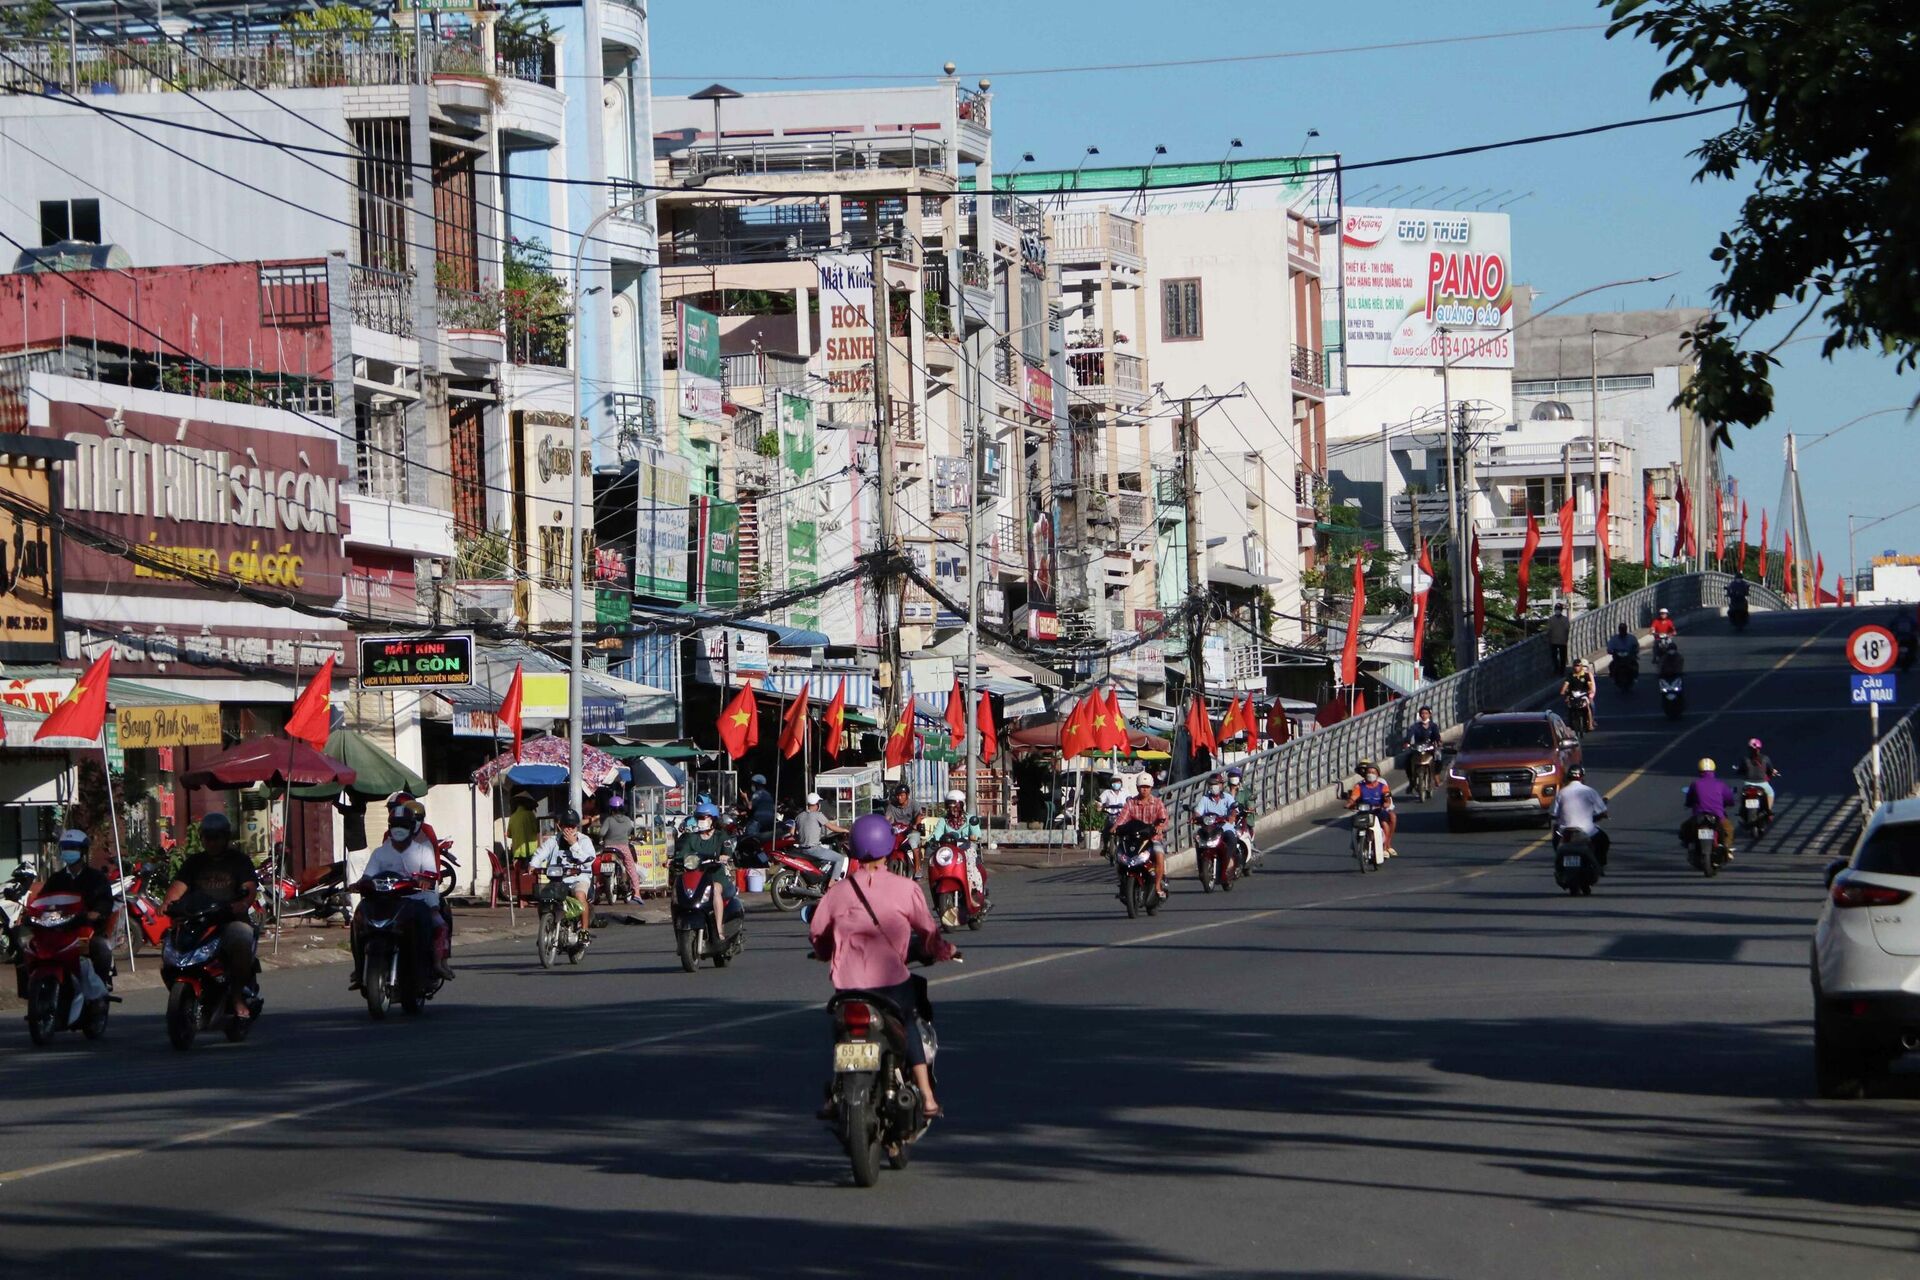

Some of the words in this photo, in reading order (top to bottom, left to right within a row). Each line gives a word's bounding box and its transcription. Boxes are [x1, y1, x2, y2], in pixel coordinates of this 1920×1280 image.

[1397, 219, 1426, 239] CHO
[1432, 217, 1469, 240] THUÊ
[821, 265, 844, 291] Mắt
[1425, 251, 1505, 321] PANO
[830, 304, 868, 329] HOA
[826, 336, 874, 361] SANH
[64, 404, 150, 515] MẮT
[231, 447, 276, 530] SÀI
[277, 450, 338, 535] GÒN
[384, 641, 411, 656] MẮT
[415, 641, 445, 654] KÍNH
[373, 656, 409, 673] SÀI
[415, 655, 460, 671] GÒN
[1853, 686, 1867, 701] CÀ
[1870, 688, 1893, 701] MAU
[120, 710, 151, 745] Song
[154, 708, 179, 737] Anh
